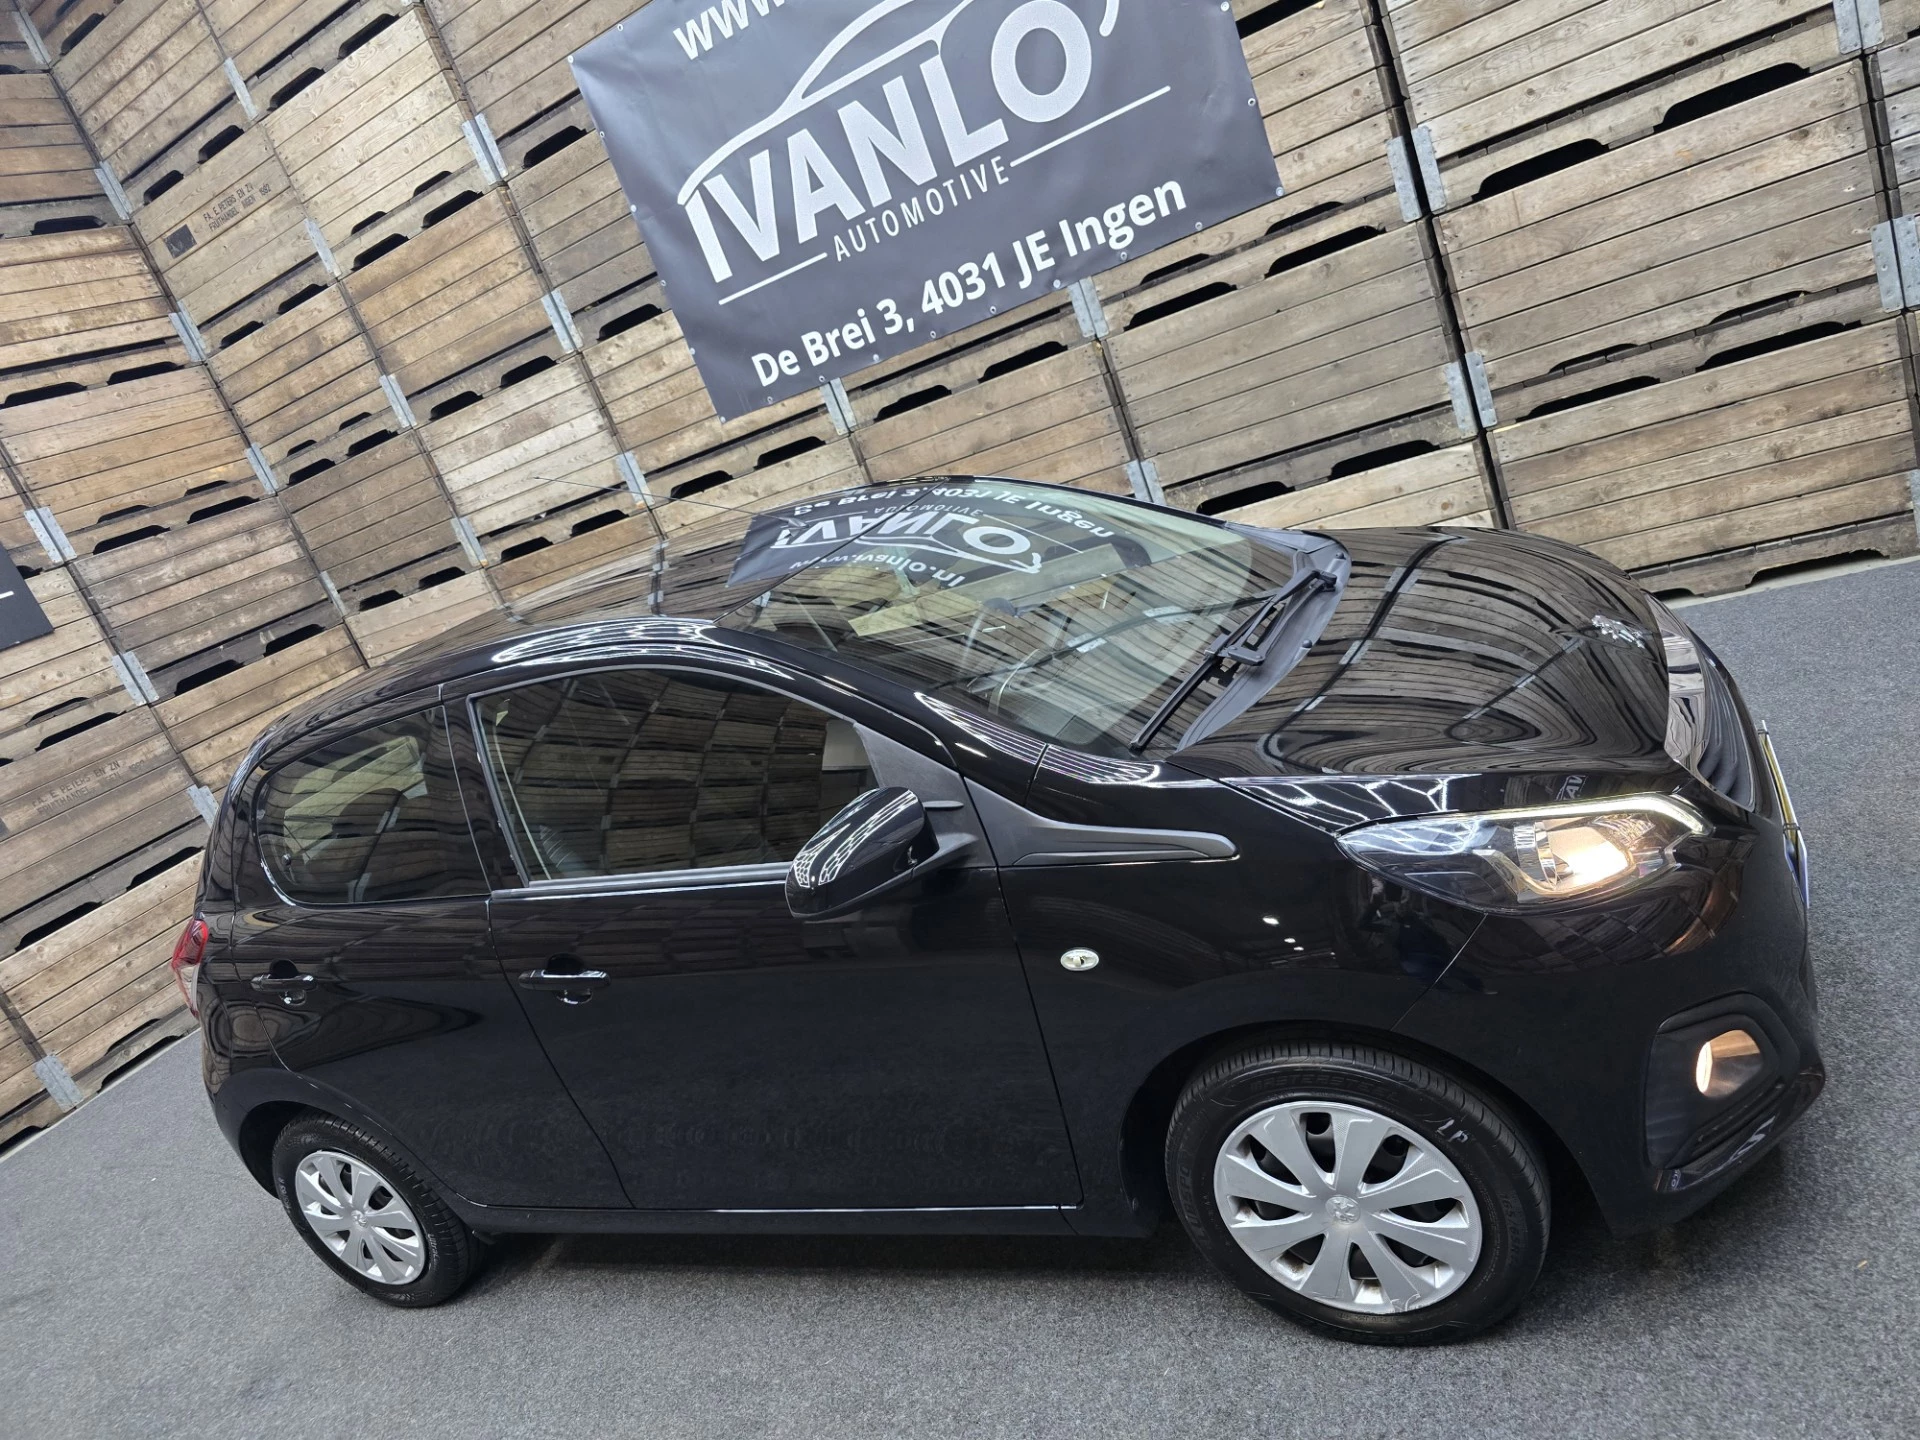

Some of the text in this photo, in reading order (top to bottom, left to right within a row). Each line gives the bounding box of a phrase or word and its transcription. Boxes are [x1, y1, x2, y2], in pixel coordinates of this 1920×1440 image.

[684, 0, 1091, 282] IVANLO
[834, 156, 1008, 261] AUTOMOTIVE
[752, 181, 1186, 386] De Brei 3, 4031 JE Ingen
